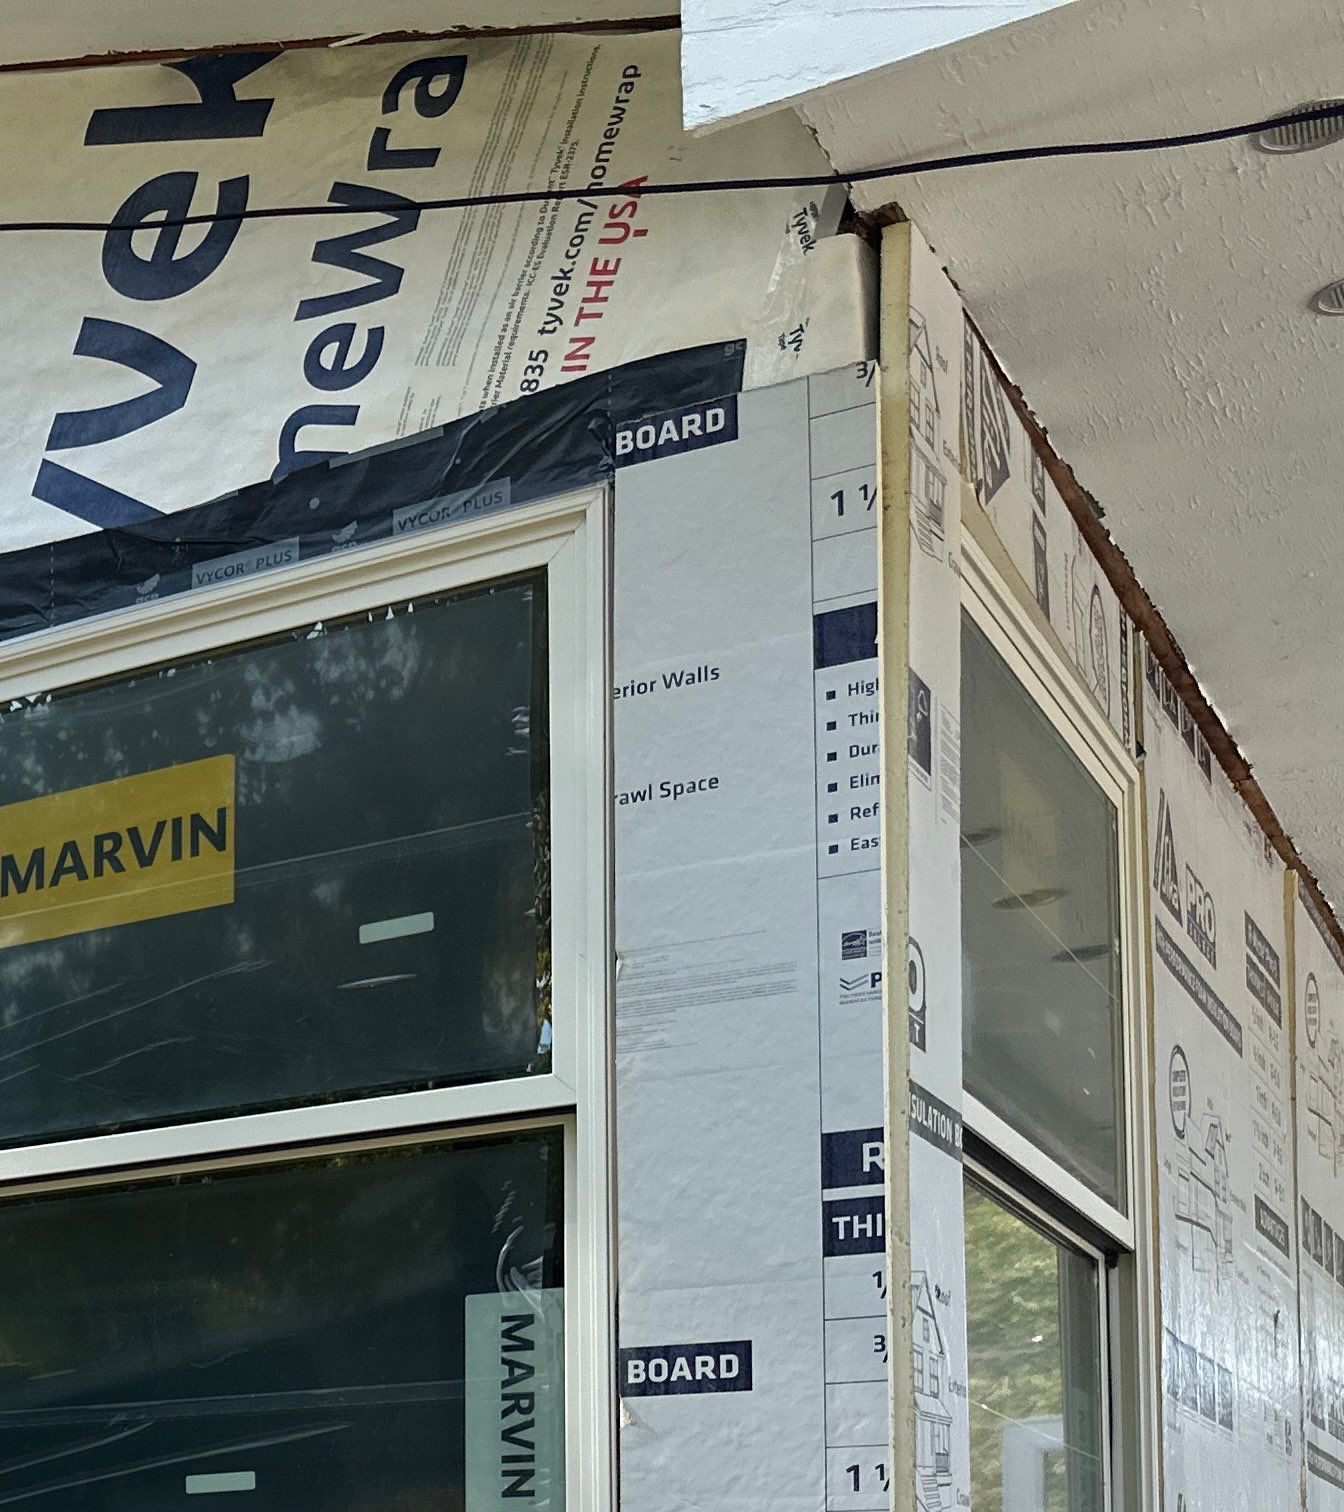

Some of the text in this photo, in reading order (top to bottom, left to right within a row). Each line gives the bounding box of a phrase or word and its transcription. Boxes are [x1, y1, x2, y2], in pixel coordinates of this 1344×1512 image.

[537, 64, 641, 336] tyvek.com/homewrap
[560, 175, 648, 372] IN THE USA
[616, 408, 725, 455] BOARD
[256, 549, 293, 571] PLUS
[661, 665, 720, 688] Walls
[660, 773, 720, 800] Space
[0, 807, 229, 899] MARVIN
[627, 1353, 739, 1385] BOARD
[500, 1314, 536, 1499] MARVIN
